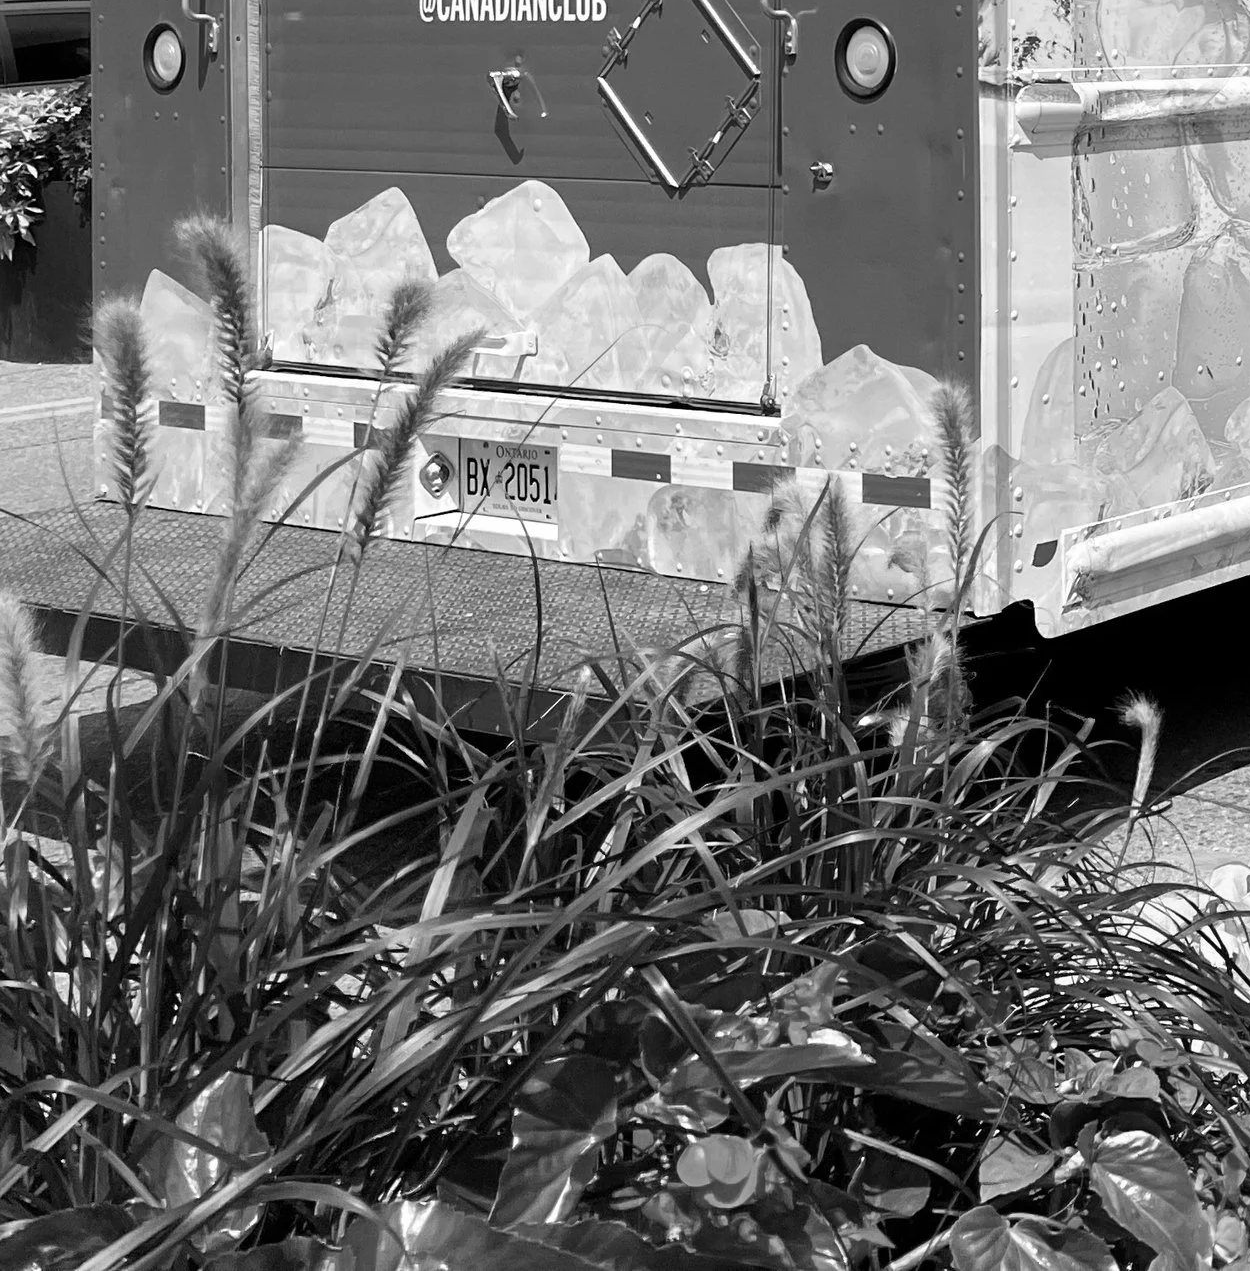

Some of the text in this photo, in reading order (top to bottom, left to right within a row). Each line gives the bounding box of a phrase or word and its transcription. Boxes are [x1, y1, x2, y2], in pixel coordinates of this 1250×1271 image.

[496, 444, 538, 459] ONTARIO
[467, 457, 552, 505] BX 2051
